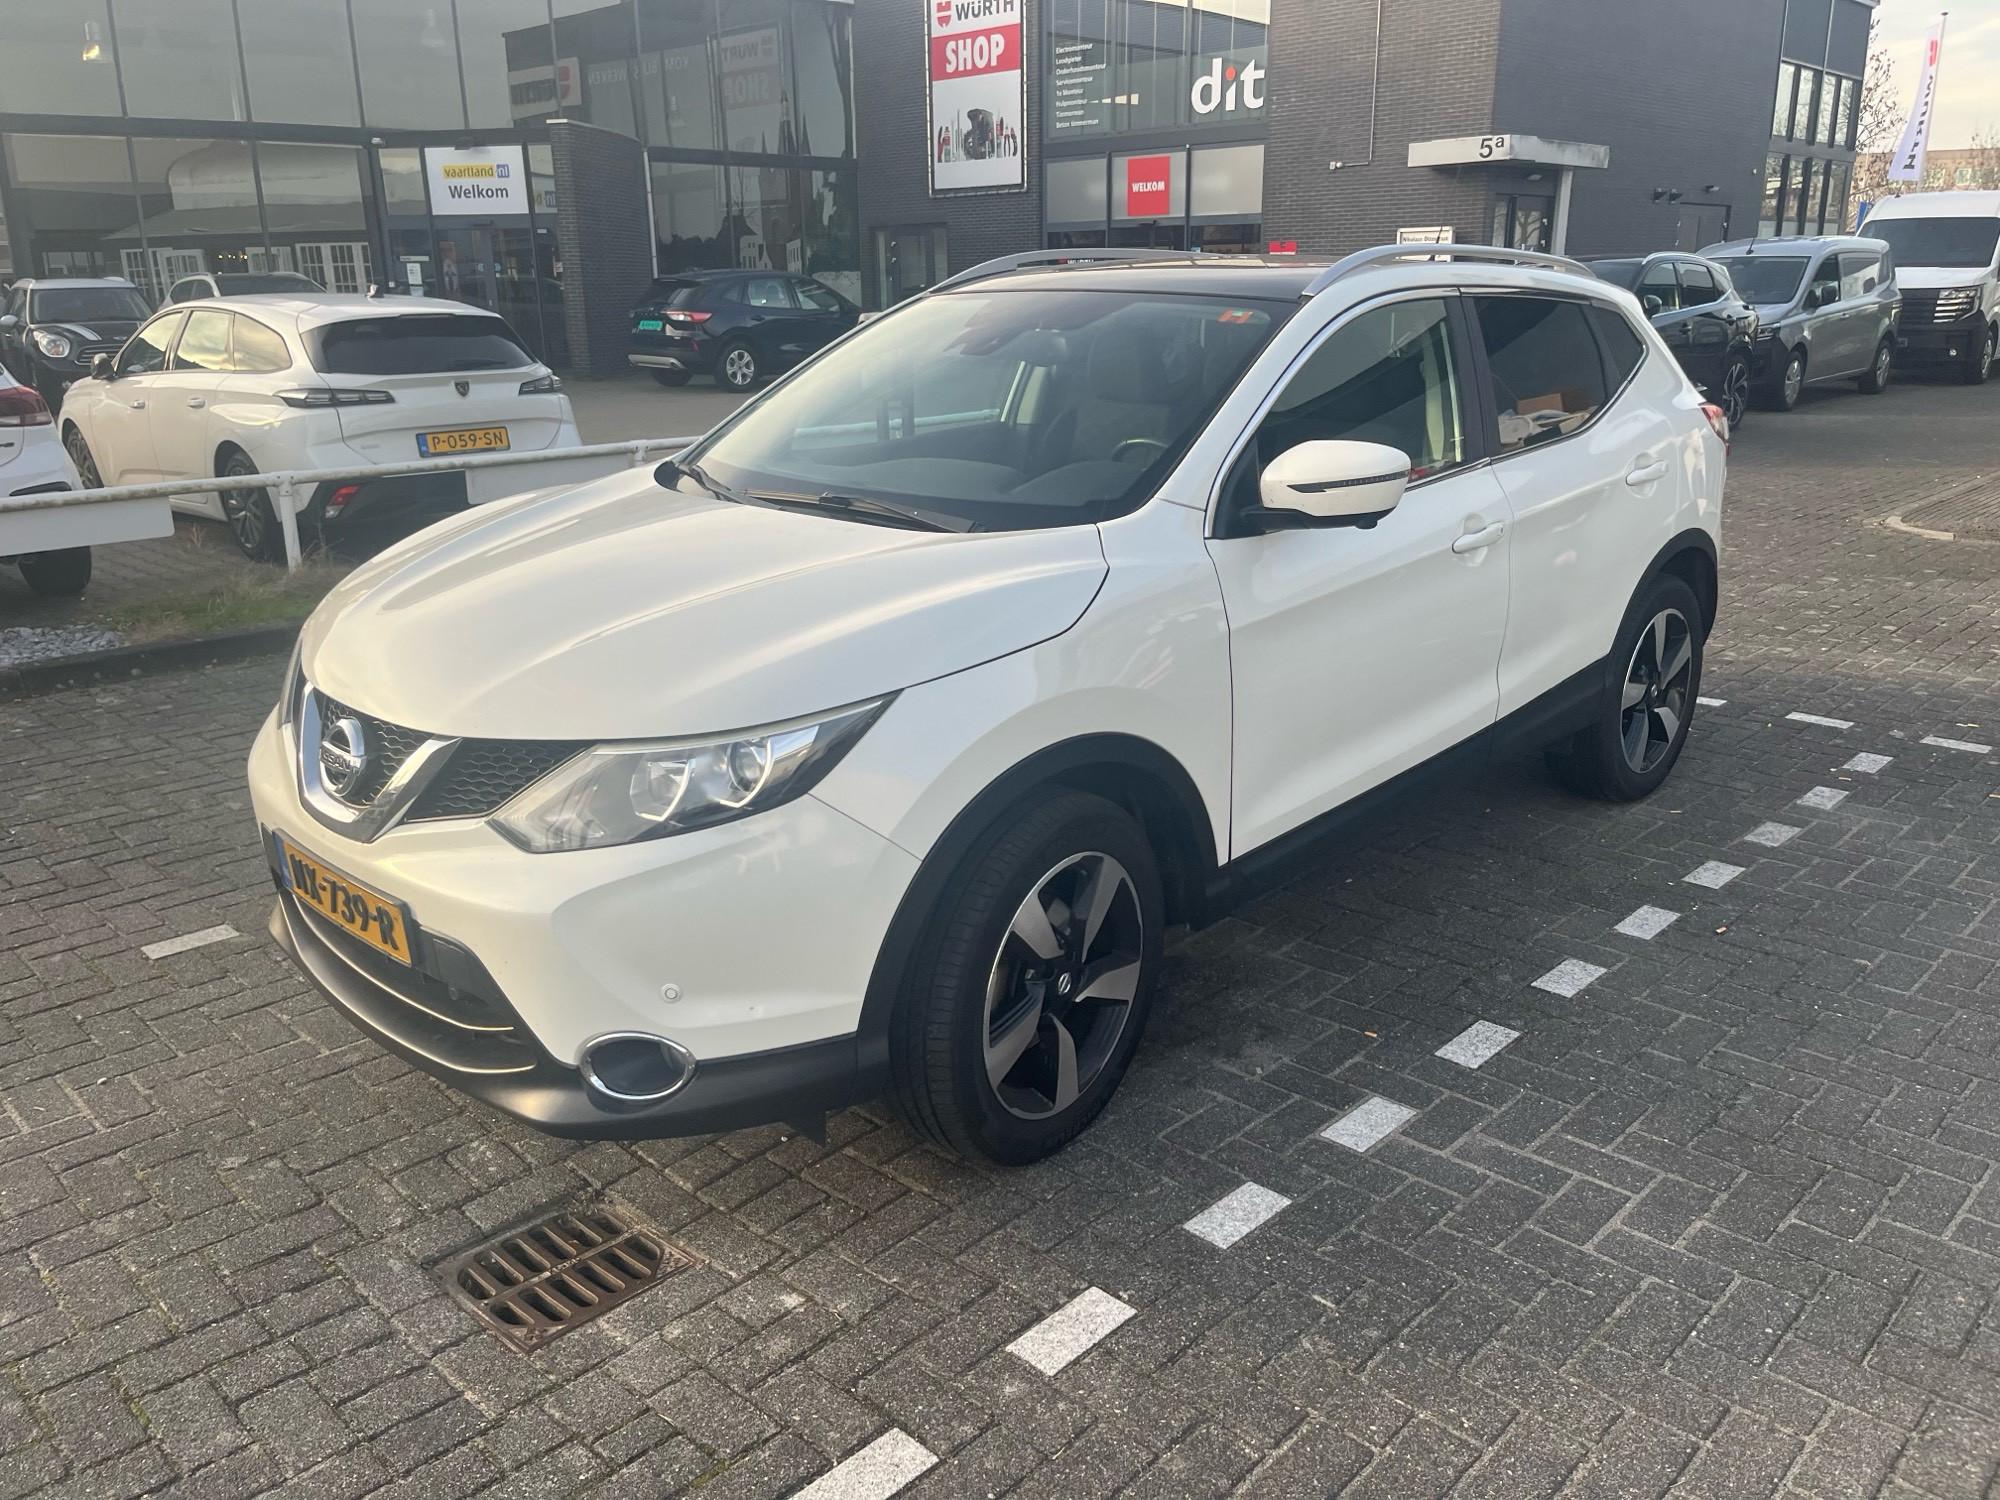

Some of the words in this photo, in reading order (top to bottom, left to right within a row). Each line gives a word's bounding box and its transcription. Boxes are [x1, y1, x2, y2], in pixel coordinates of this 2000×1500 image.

[955, 0, 1014, 21] WÜRTH
[945, 33, 1005, 73] SHOP
[1191, 57, 1265, 114] dit
[448, 184, 509, 199] Welkom
[1132, 180, 1165, 193] WELKOM
[431, 431, 504, 450] P-059-SN
